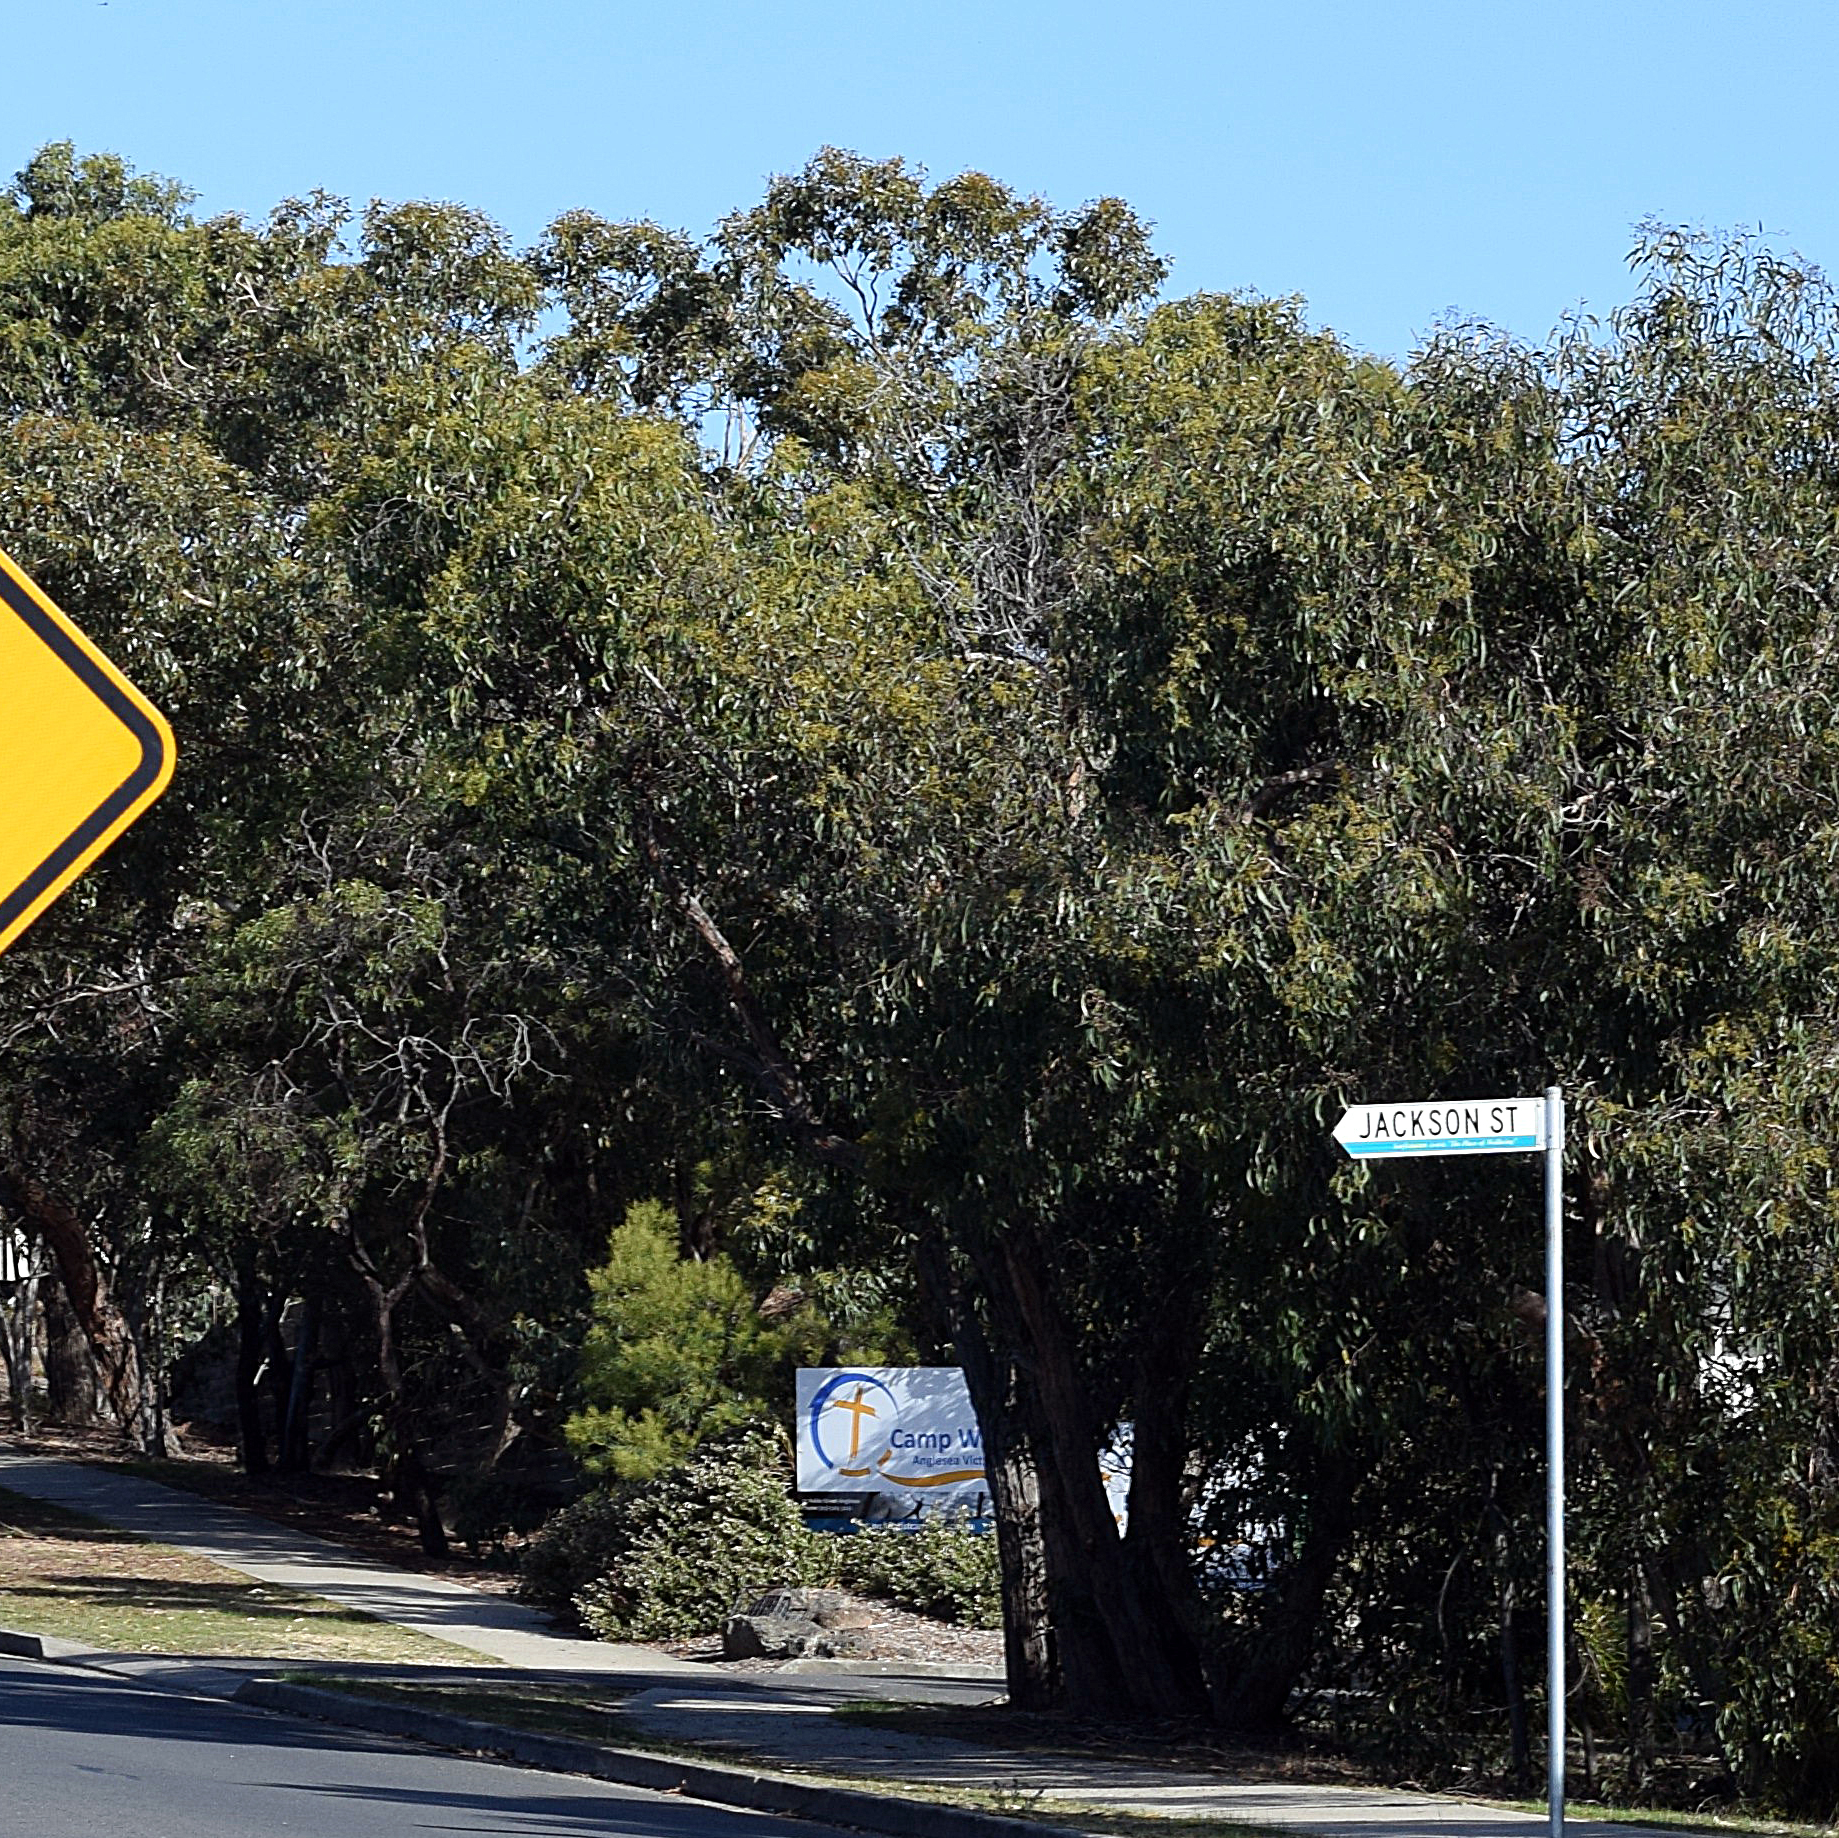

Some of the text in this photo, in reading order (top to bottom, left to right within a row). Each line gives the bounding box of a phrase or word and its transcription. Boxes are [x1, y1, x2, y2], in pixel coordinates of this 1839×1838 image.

[1359, 1106, 1518, 1138] JACKSON ST
[890, 1428, 951, 1453] Camp
[912, 1455, 959, 1468] Anglesea
